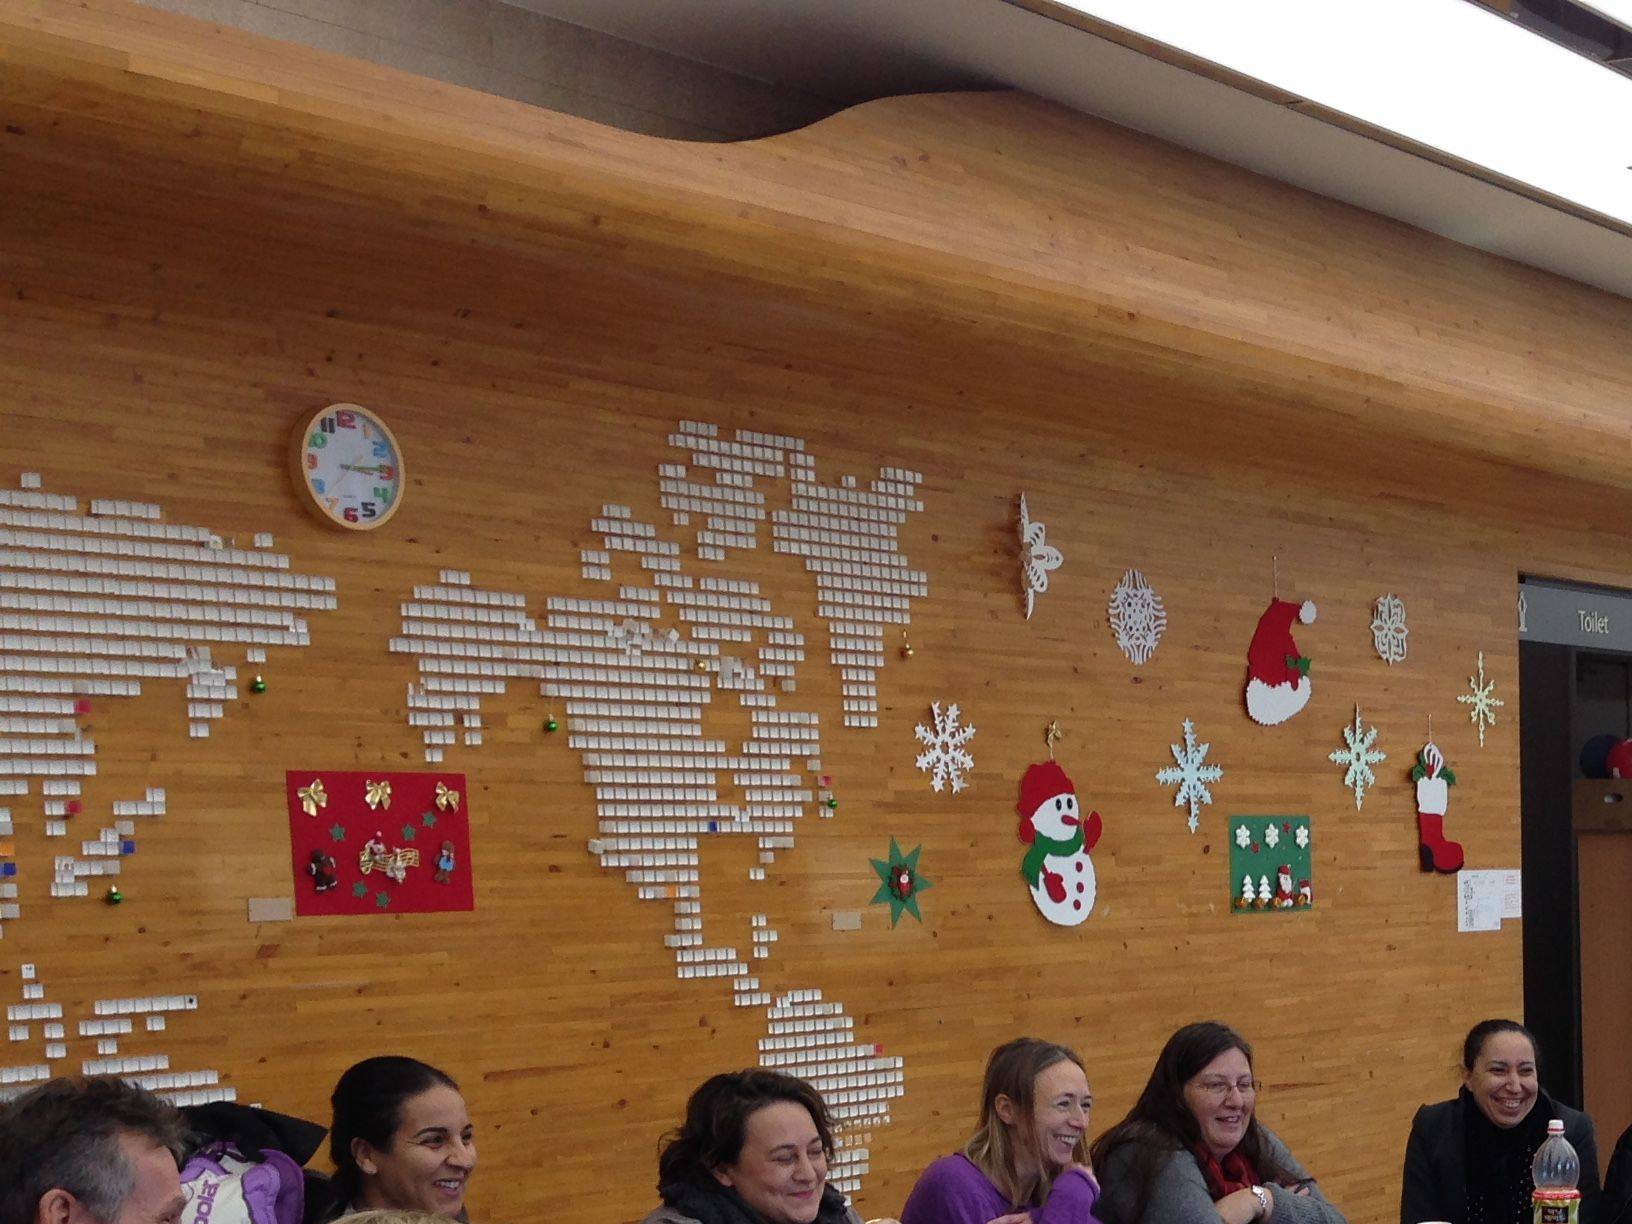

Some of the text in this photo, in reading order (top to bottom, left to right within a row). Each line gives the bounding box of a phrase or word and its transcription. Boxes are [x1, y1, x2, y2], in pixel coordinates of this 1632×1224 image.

[321, 417, 335, 434] 11
[336, 410, 357, 429] 12
[372, 440, 388, 458] 2
[307, 453, 318, 470] 9
[379, 464, 395, 481] 3
[373, 486, 391, 504] 4
[325, 496, 340, 512] 7
[361, 501, 377, 518] 5
[343, 506, 359, 523] 6
[1577, 610, 1609, 634] Toilet
